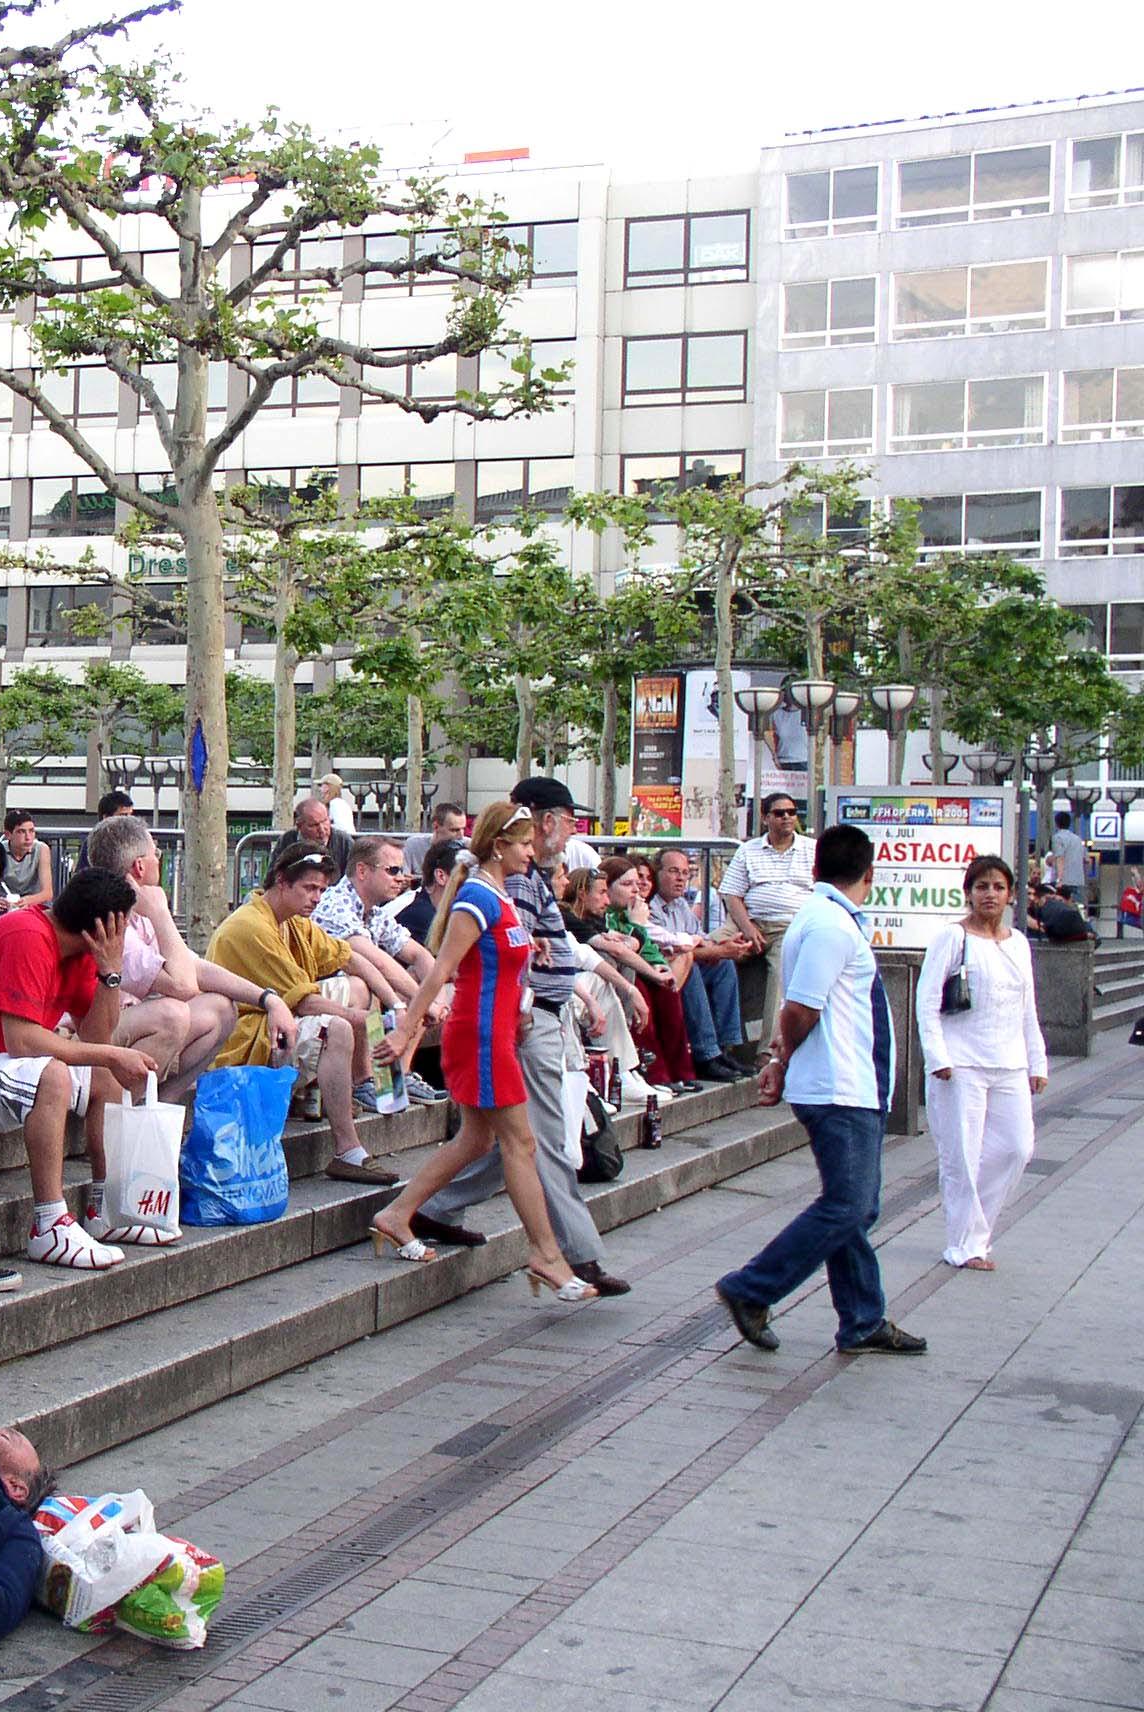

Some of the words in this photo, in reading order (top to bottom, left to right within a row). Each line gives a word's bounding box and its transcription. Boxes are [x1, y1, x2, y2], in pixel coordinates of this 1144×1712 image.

[872, 807, 891, 817] FFH
[893, 808, 924, 818] OPERN
[927, 808, 943, 818] AIR
[885, 829, 894, 838] 6.
[895, 829, 915, 838] JULI
[872, 842, 977, 863] ASTACIA
[893, 873, 900, 883] 7.
[902, 874, 922, 883] JULI
[910, 887, 964, 908] MUS
[874, 917, 882, 927] 8.
[884, 918, 903, 928] JULI
[138, 1190, 171, 1216] H&M
